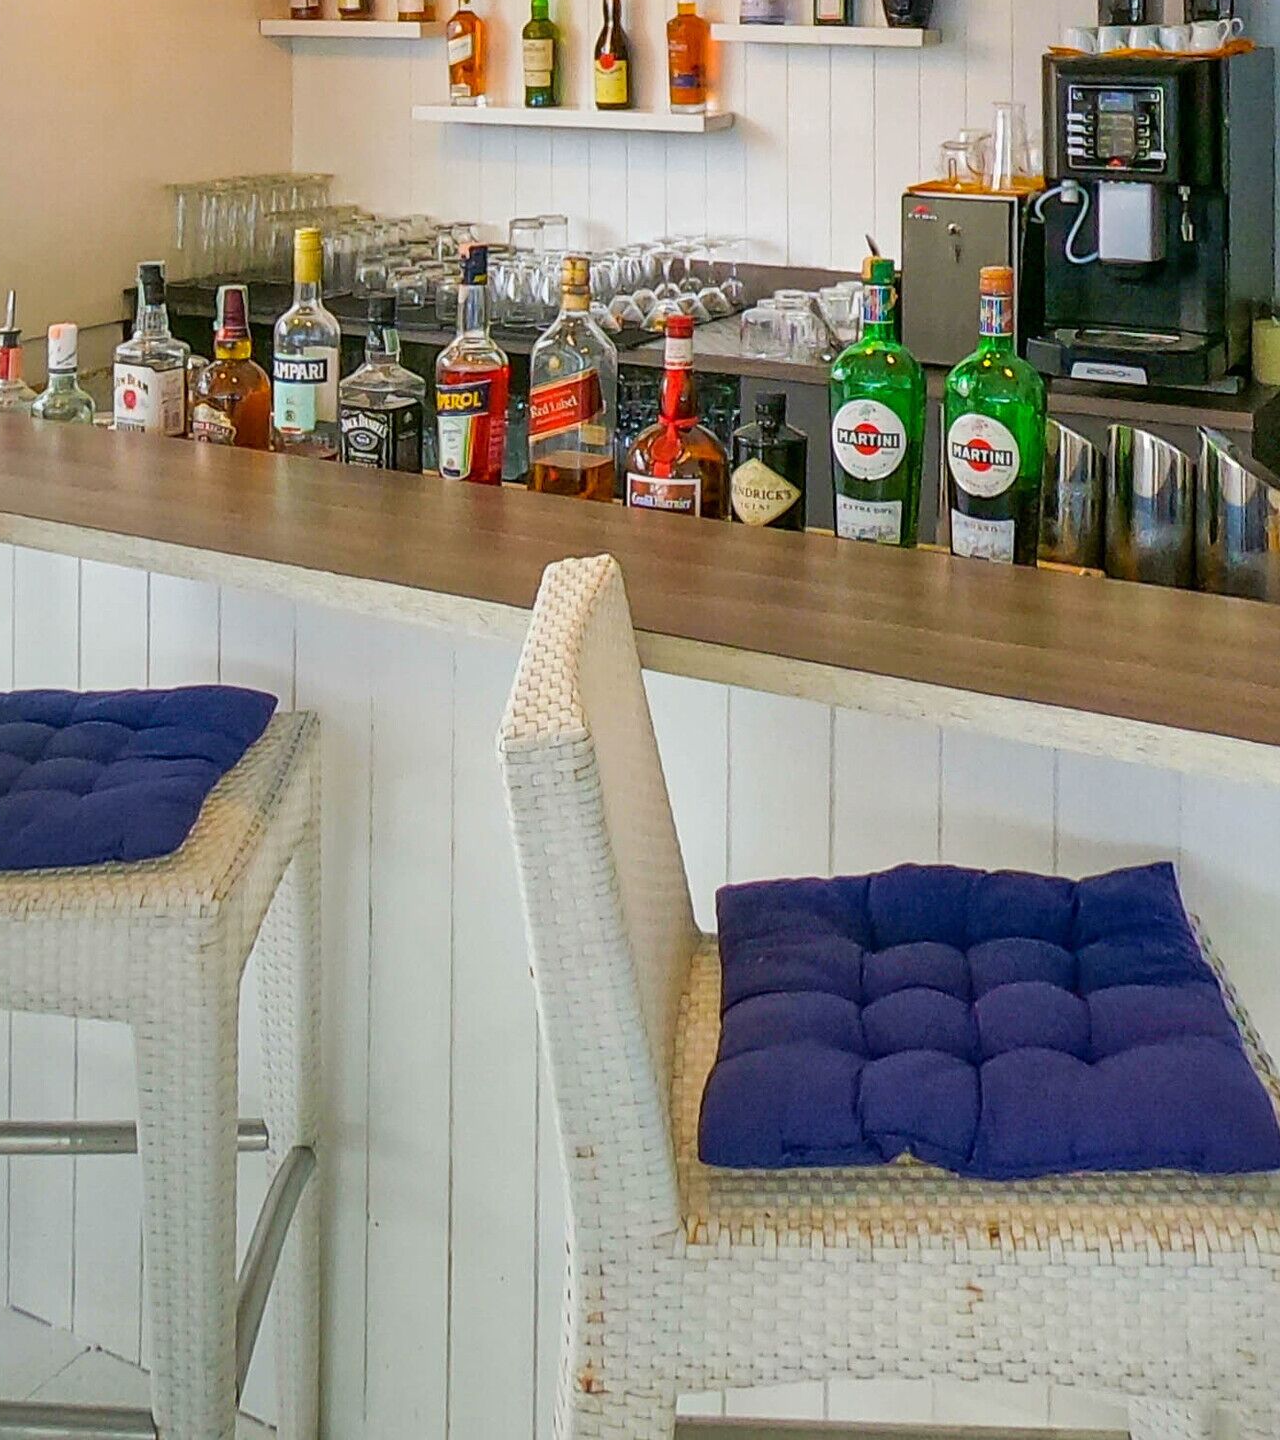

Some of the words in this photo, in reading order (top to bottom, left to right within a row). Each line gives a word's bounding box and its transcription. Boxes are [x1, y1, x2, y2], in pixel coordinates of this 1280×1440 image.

[273, 361, 324, 380] AMPARI
[437, 391, 481, 410] PEROL
[838, 430, 898, 449] MARTINI
[952, 445, 1012, 466] MARTINI
[736, 486, 792, 501] NDRICK'S
